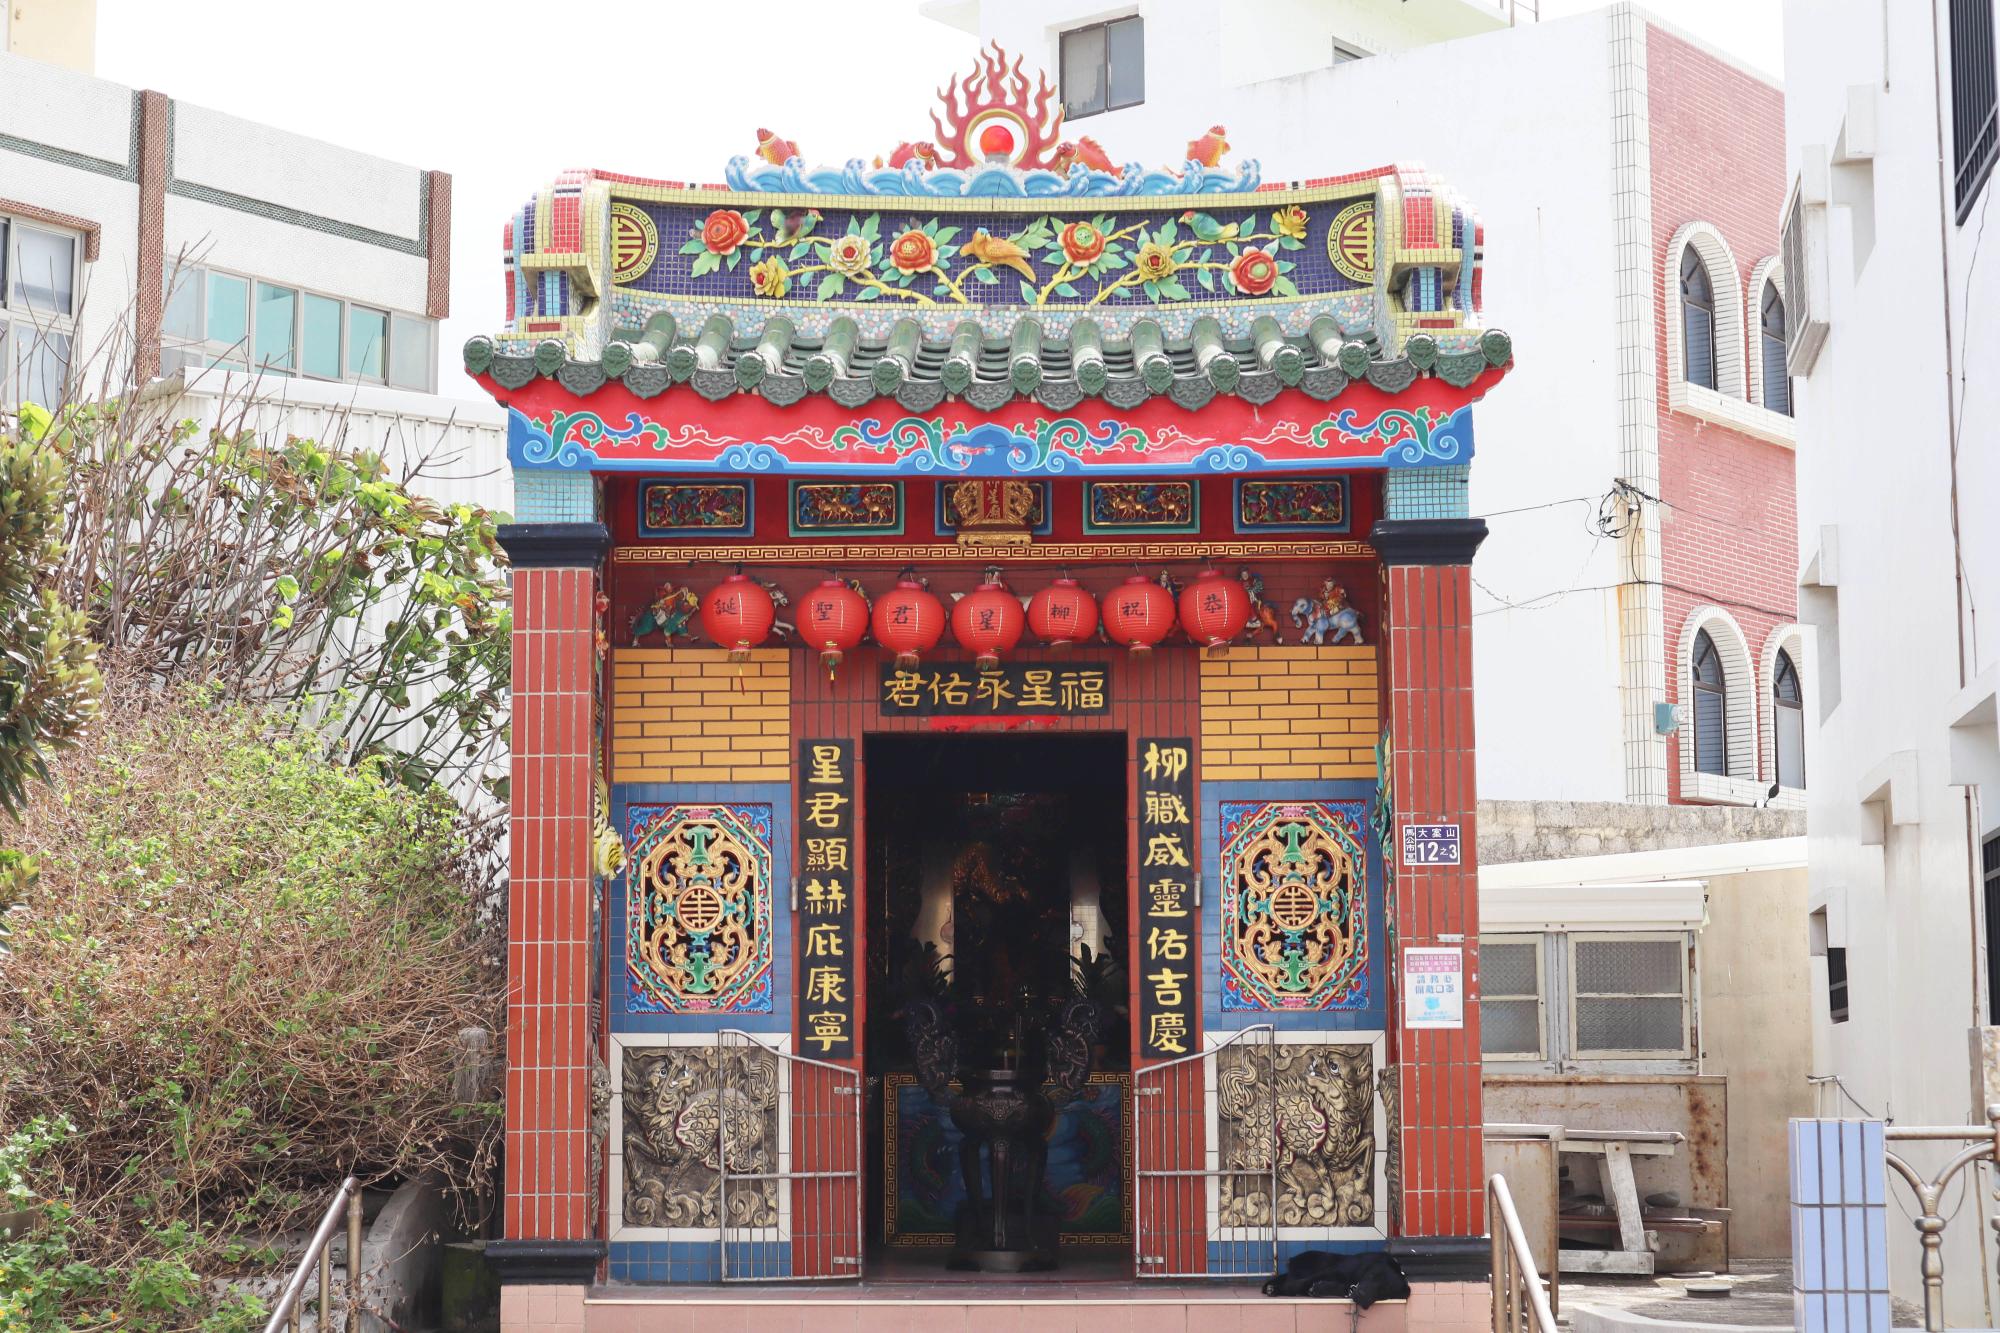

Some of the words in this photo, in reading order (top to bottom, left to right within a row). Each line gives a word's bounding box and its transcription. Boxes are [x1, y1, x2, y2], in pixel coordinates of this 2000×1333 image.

[713, 598, 737, 616] 誕
[816, 601, 833, 621] 聖
[891, 605, 913, 625] 君
[1050, 602, 1070, 620] 柳
[1121, 601, 1144, 618] 祝
[979, 608, 997, 631] 星
[1417, 841, 1458, 862] 12之3
